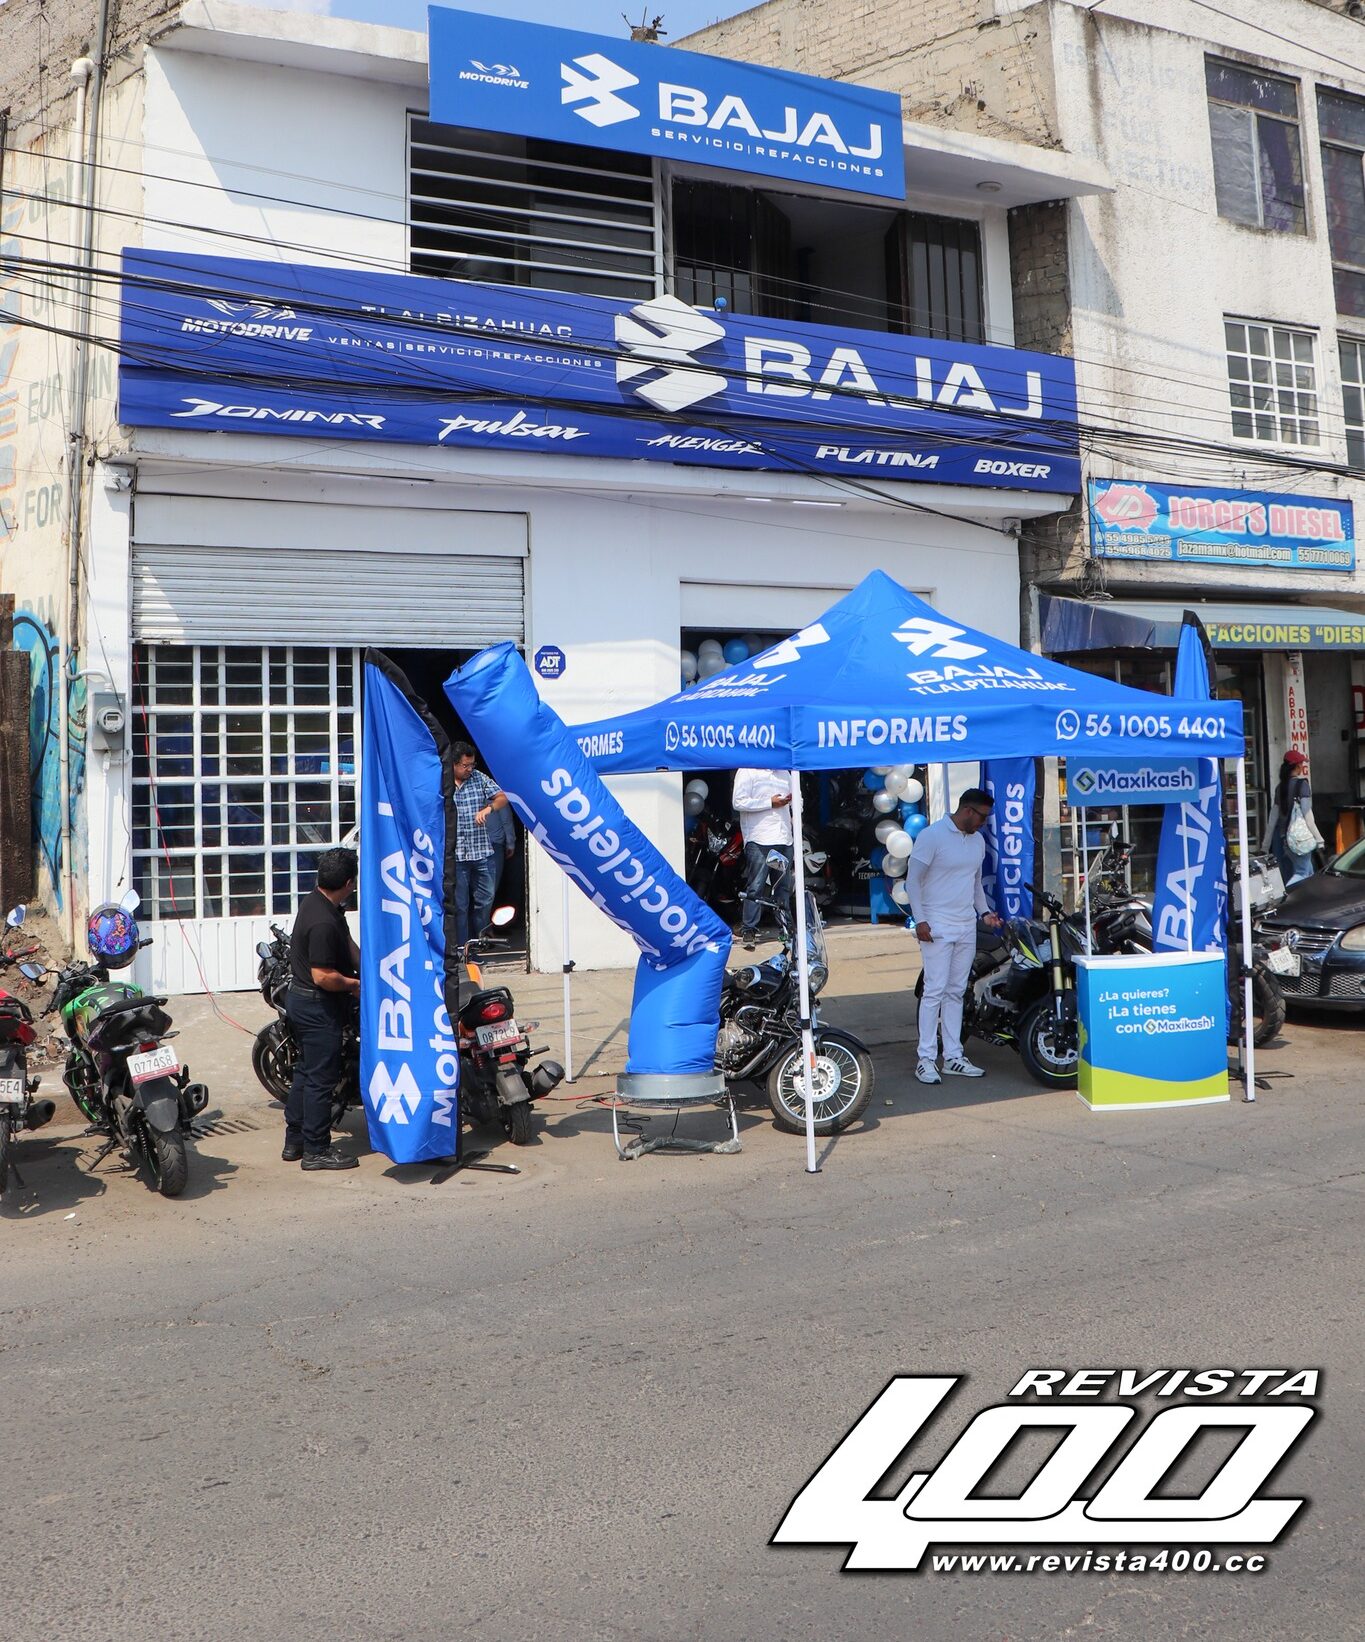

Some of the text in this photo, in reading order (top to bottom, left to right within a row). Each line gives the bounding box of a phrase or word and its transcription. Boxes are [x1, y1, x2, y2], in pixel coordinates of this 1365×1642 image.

[459, 71, 529, 89] MOTODRIVE
[658, 82, 883, 160] BAJAJ
[181, 318, 312, 342] MOTODRIVE
[744, 336, 1044, 420] BAJAJ
[636, 434, 766, 455] AVENGER
[815, 445, 940, 470] PLATINA
[973, 459, 1051, 480] BOXER
[1168, 495, 1346, 542] JORGE'S DIESEL
[1207, 623, 1311, 644] FACCIONES
[540, 655, 561, 668] ADT
[906, 664, 1044, 685] BAJAJ
[908, 678, 1077, 696] TLALPIZAHUAC
[682, 724, 776, 749] 56 1005 4401
[817, 715, 969, 748] INFORMES
[1085, 714, 1226, 740] 56 1005 4401
[1098, 767, 1193, 791] Maxikash
[1098, 987, 1170, 1003] ¿La quieres?
[1108, 1002, 1177, 1020] ¡La tienes
[1115, 1023, 1143, 1034] con
